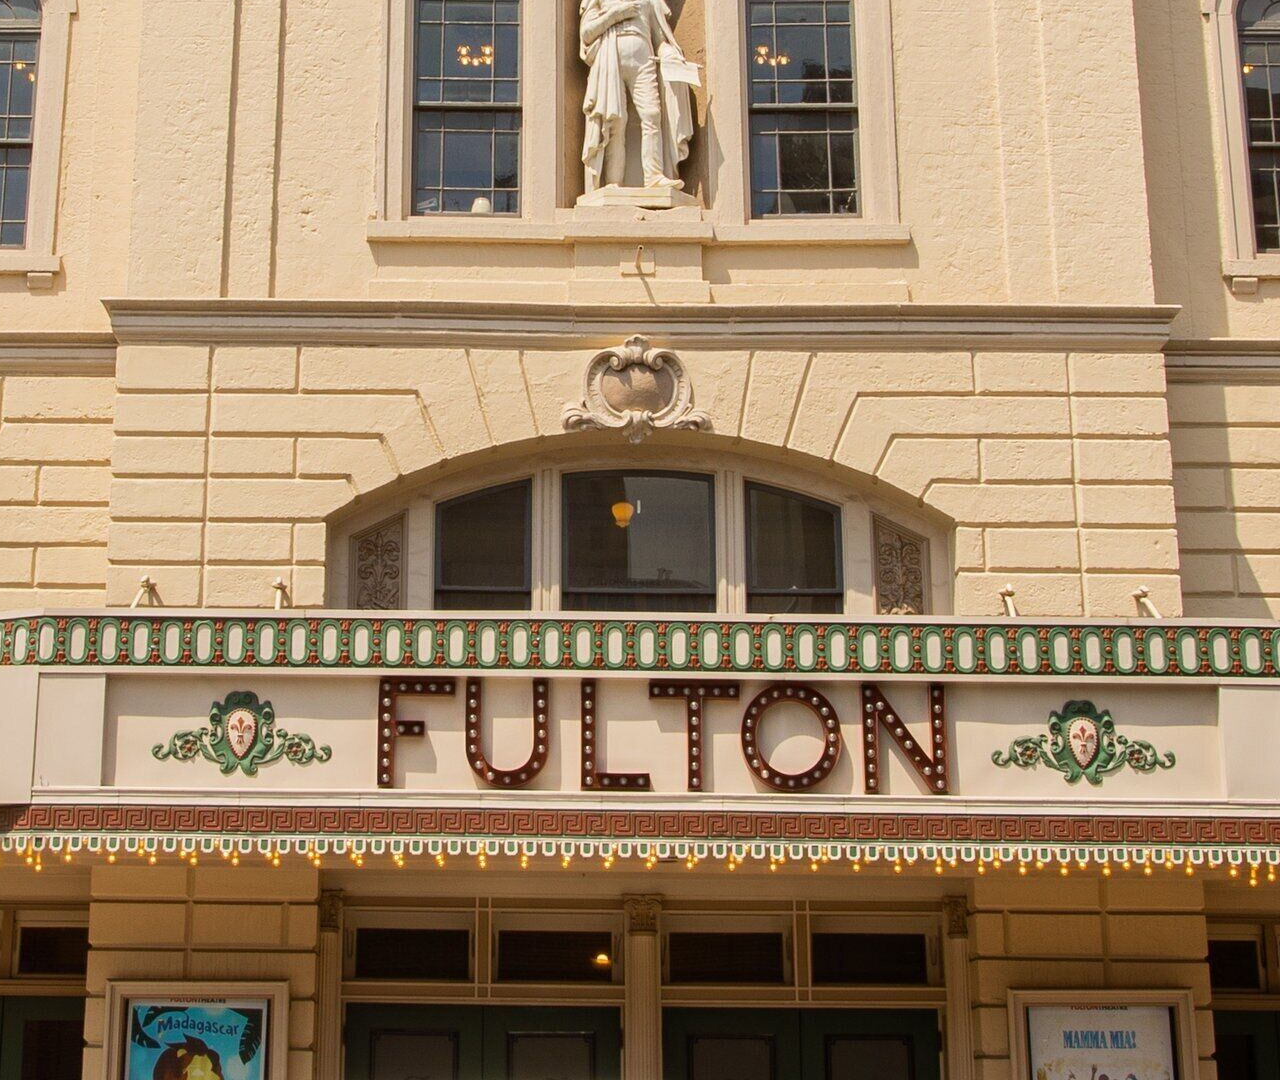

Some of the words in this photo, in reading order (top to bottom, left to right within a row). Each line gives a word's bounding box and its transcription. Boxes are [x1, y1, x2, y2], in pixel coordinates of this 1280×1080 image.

[377, 677, 950, 794] FULTON
[157, 1015, 240, 1036] Madagascar
[1062, 1030, 1108, 1049] MAMMA
[1109, 1030, 1137, 1049] MIA!
